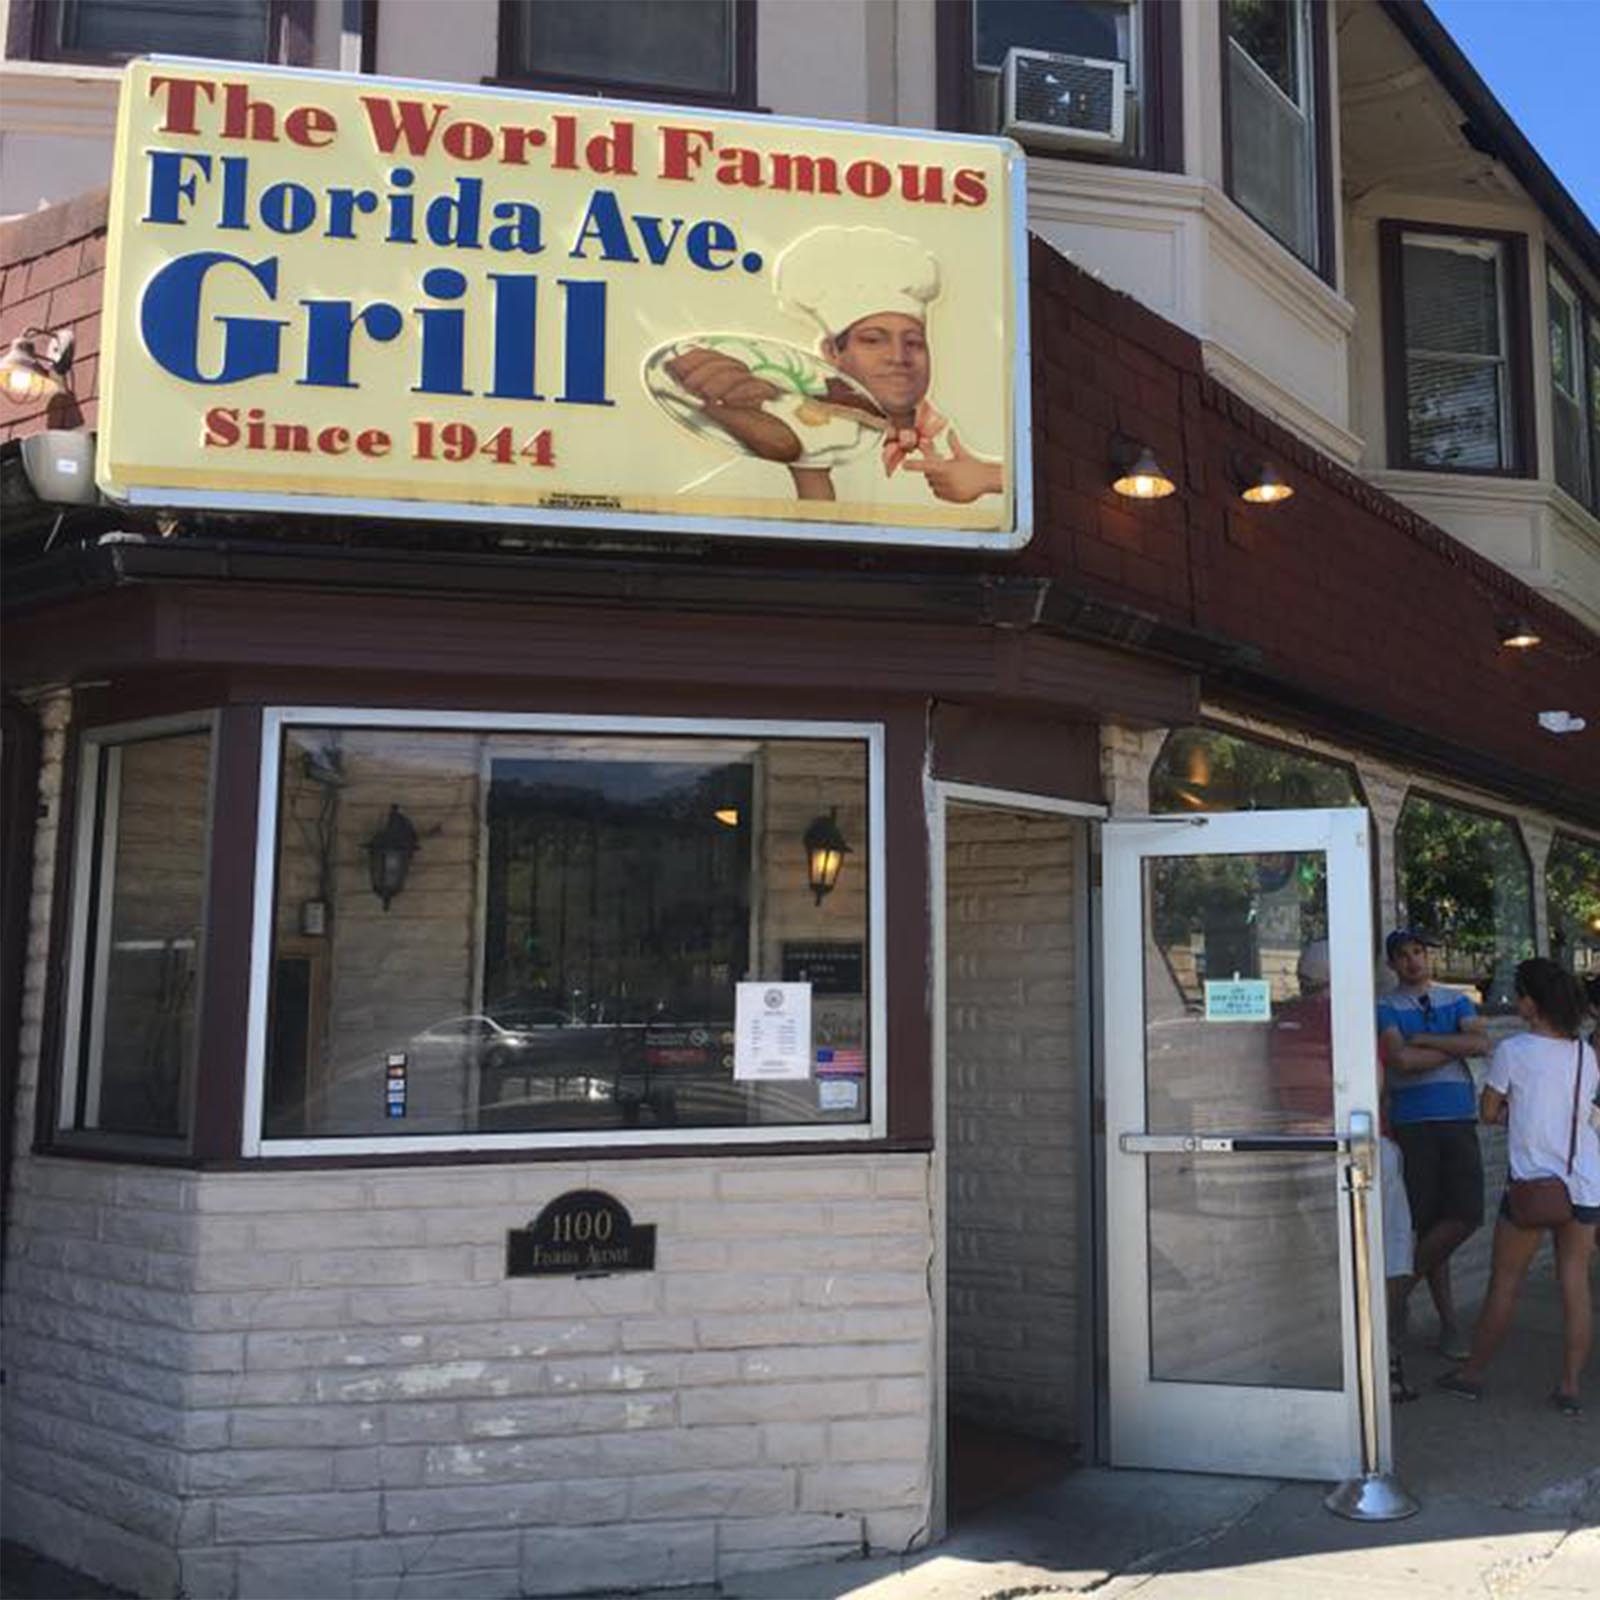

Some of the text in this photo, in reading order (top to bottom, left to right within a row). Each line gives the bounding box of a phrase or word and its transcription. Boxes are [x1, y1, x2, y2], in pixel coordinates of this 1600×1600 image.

[150, 76, 989, 208] The World Famous
[142, 149, 764, 273] Florida Ave.
[140, 250, 615, 407] Grill
[203, 407, 557, 467] Since 1944
[552, 1209, 612, 1242] 1100
